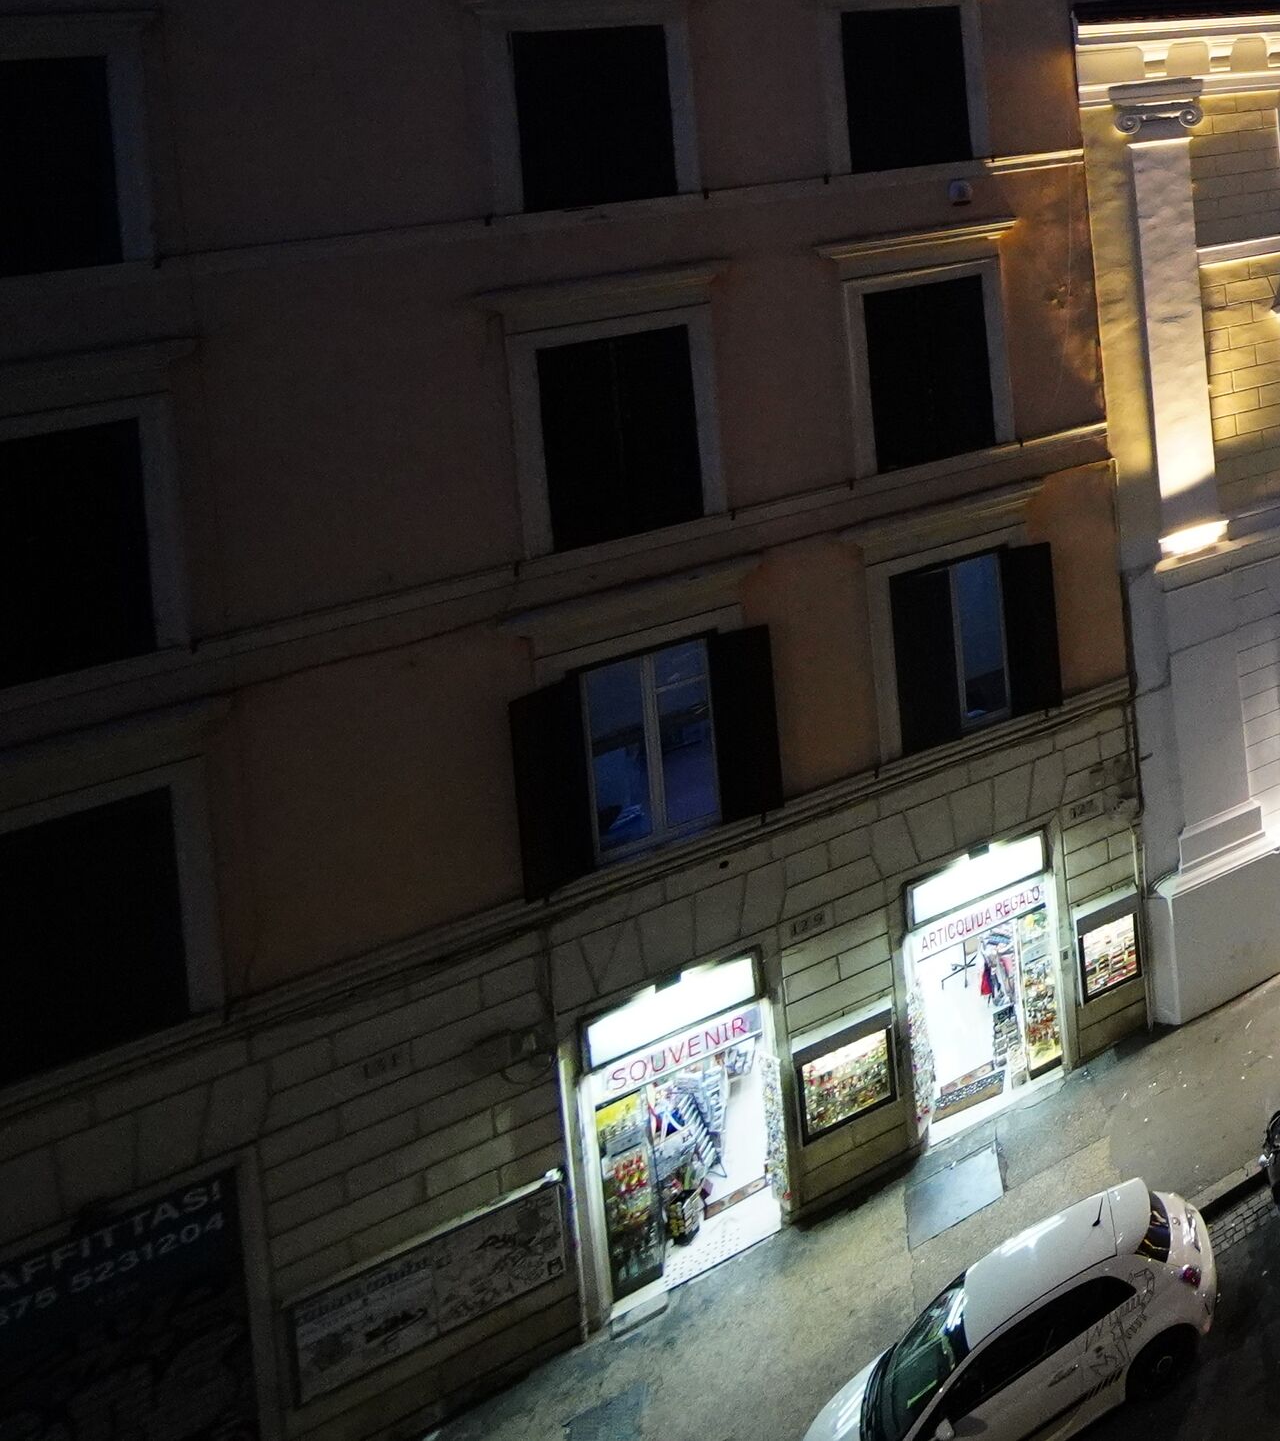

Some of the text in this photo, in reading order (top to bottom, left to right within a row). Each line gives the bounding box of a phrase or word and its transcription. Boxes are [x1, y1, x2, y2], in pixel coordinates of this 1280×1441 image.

[994, 884, 1041, 917] REGALO
[610, 1016, 748, 1091] SOUVENIR
[69, 1211, 225, 1295] 5231204
